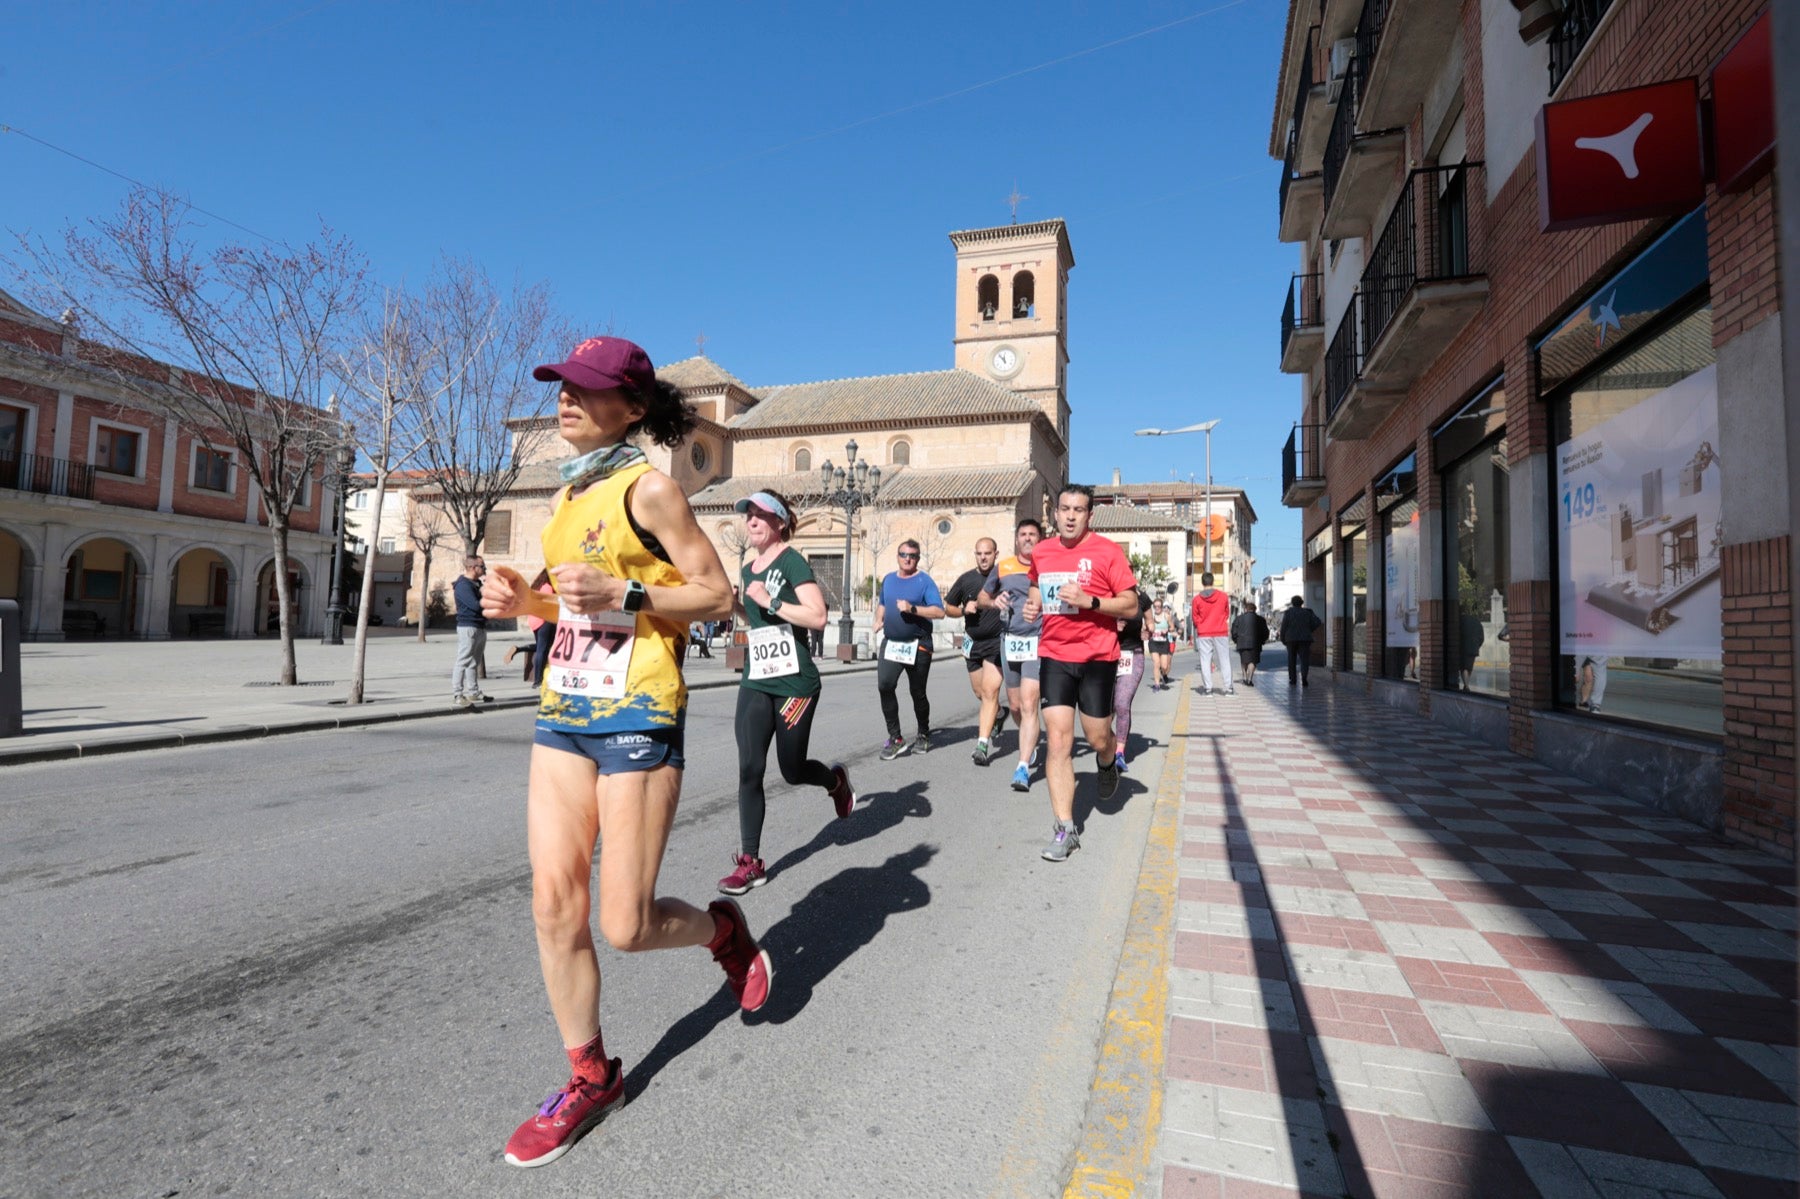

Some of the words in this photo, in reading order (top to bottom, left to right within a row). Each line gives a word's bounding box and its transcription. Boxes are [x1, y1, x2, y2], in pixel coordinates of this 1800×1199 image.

[1563, 482, 1595, 523] 149
[551, 626, 629, 663] 2077
[753, 640, 791, 661] 3020
[1010, 640, 1031, 652] 321
[604, 738, 616, 746] AL
